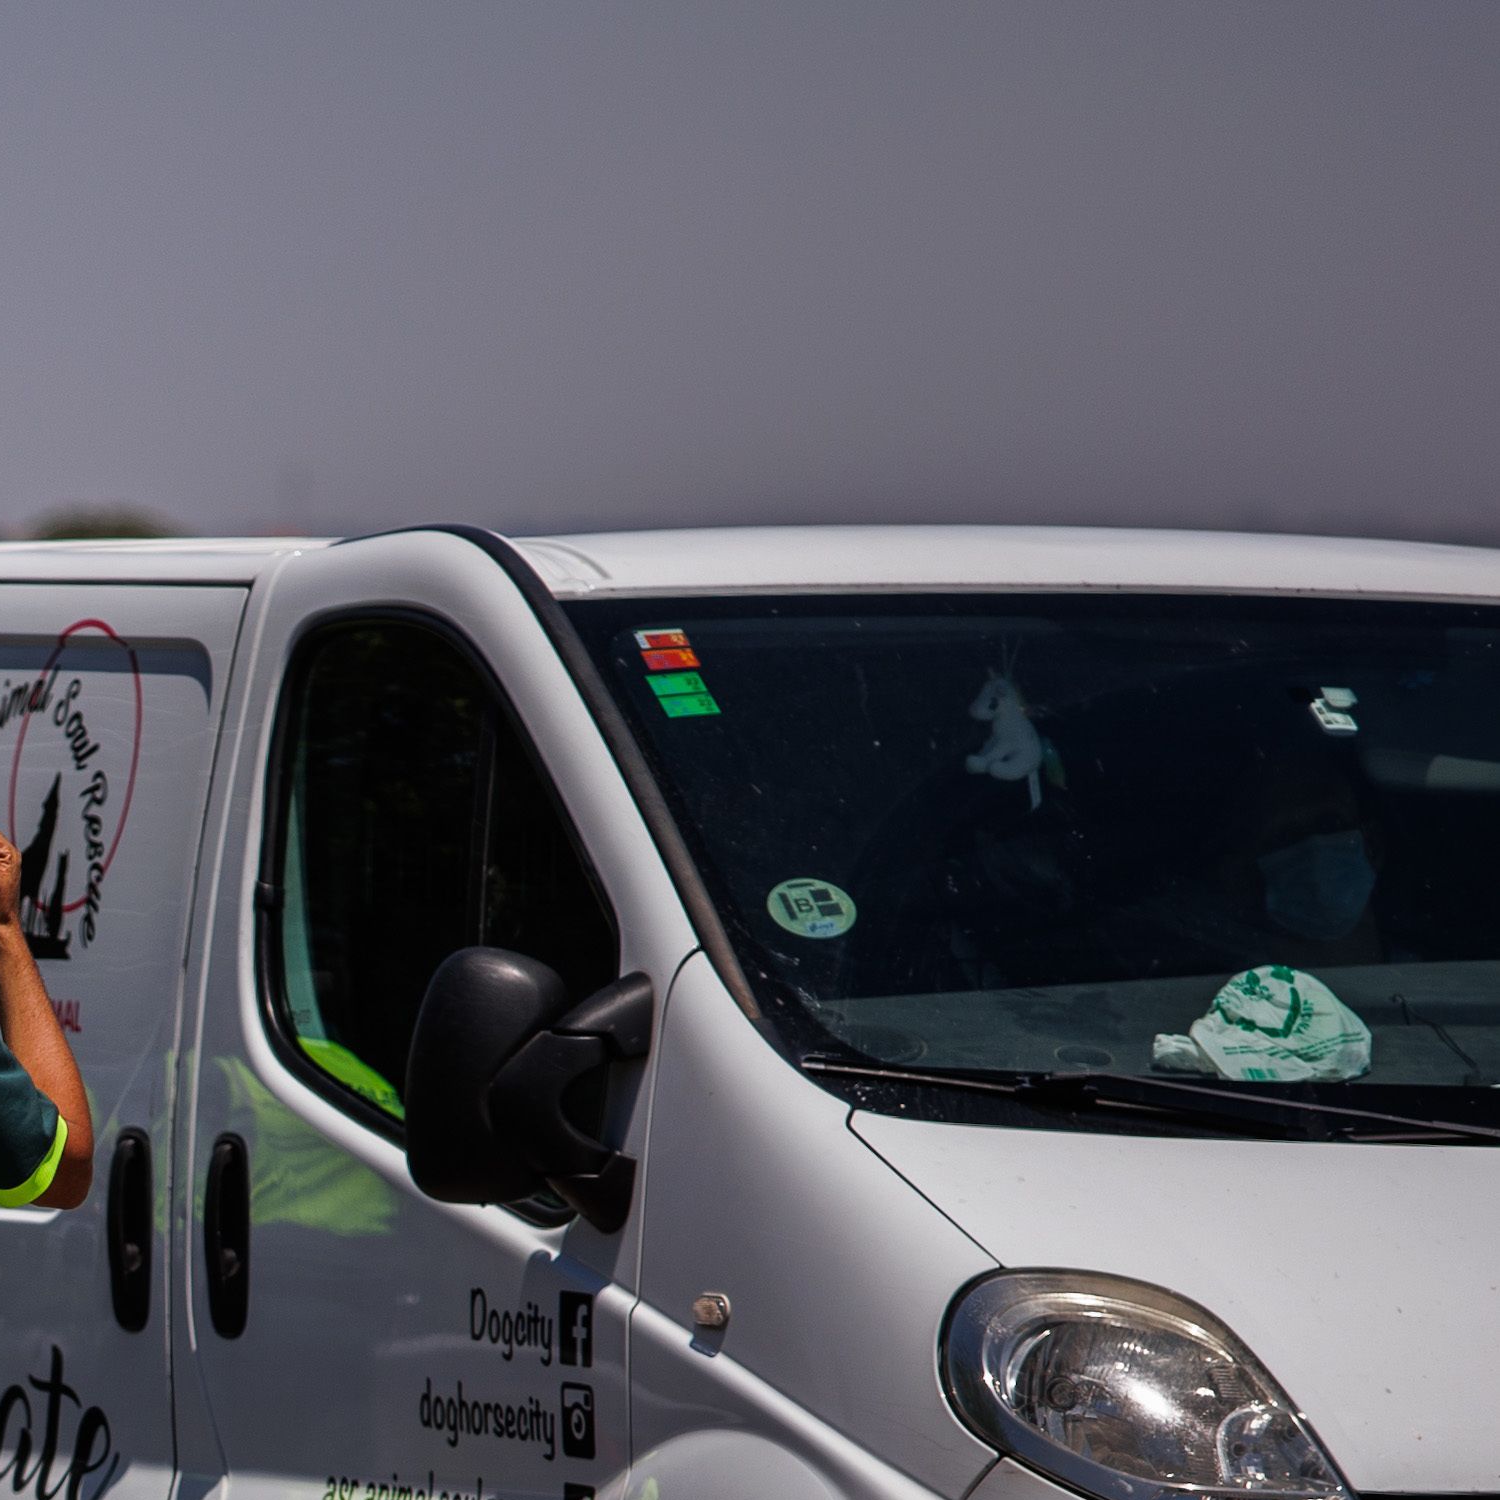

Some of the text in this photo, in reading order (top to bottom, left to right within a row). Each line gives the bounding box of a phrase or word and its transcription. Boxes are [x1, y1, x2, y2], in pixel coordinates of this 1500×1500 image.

[54, 679, 100, 770] Soul
[79, 770, 109, 948] Rescue
[795, 898, 814, 913] B
[470, 1287, 554, 1367] Dogcity
[419, 1376, 556, 1462] doghorsecity
